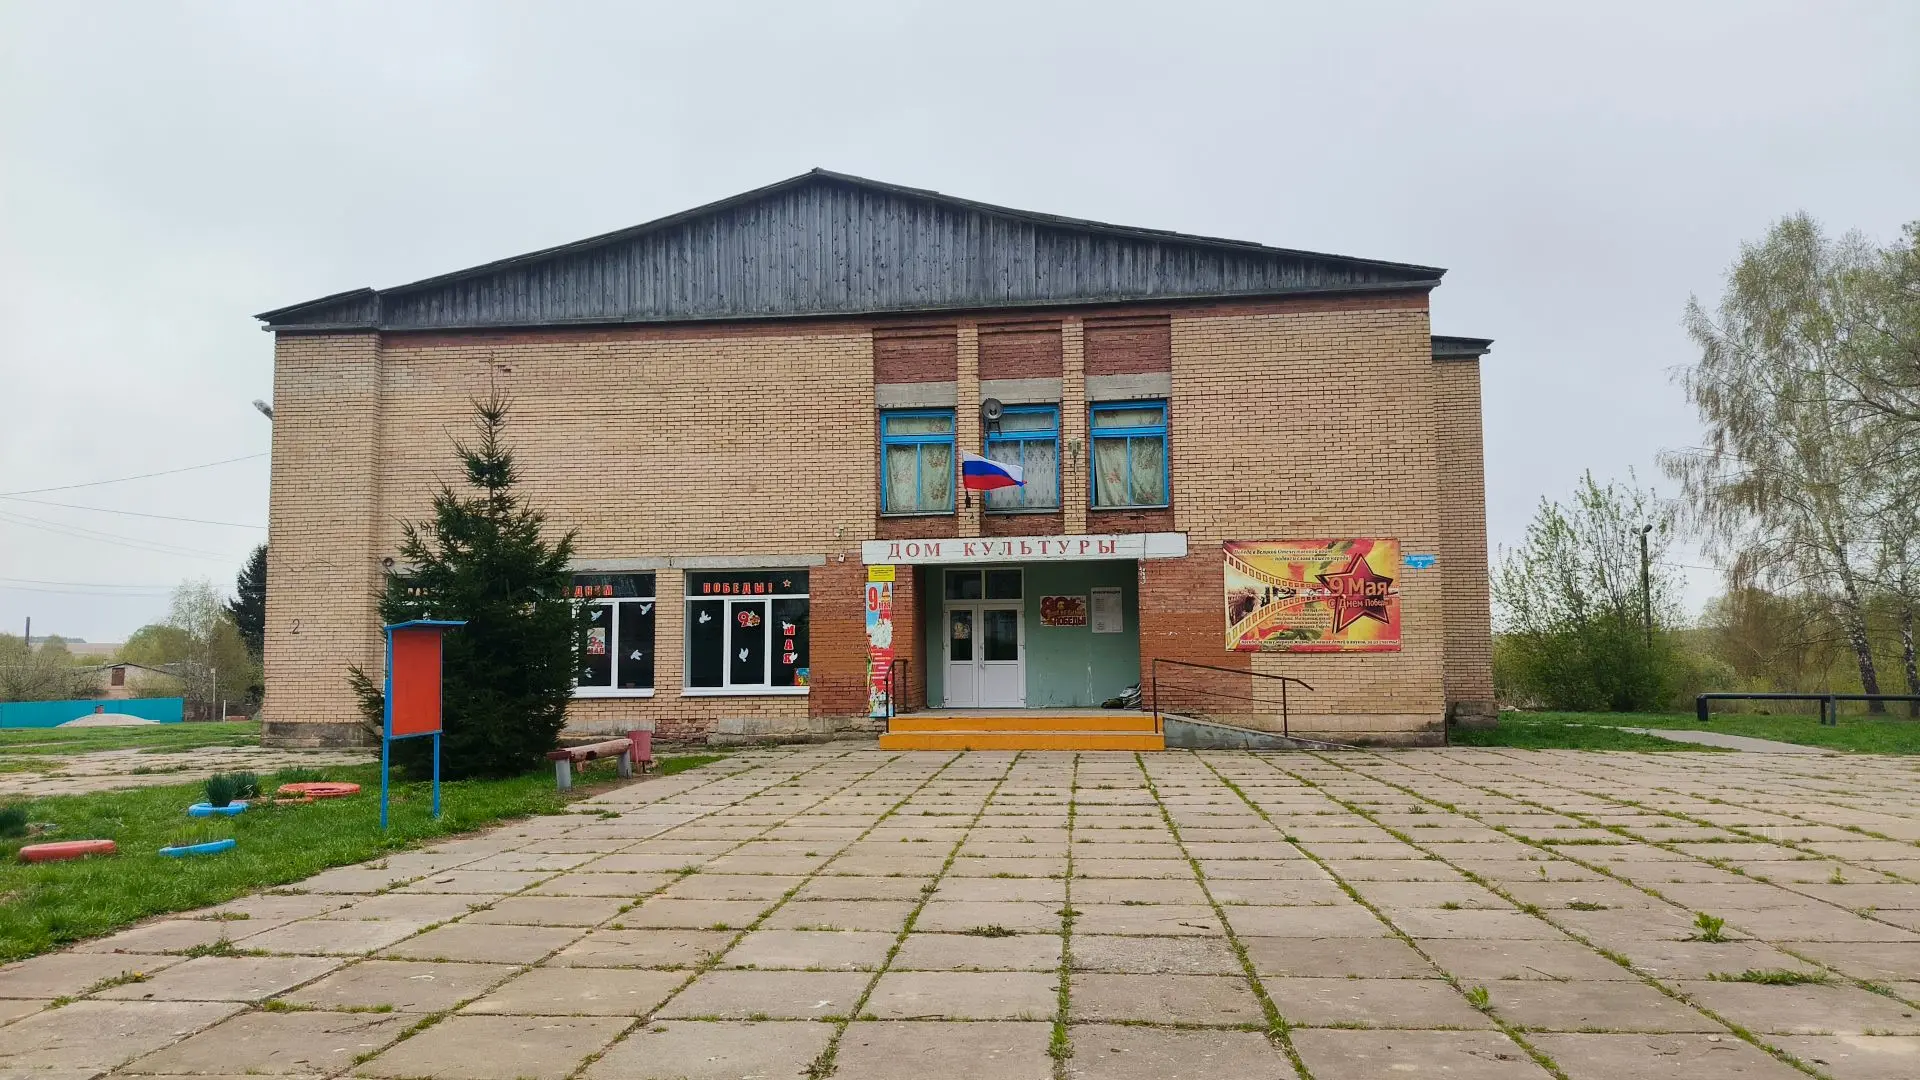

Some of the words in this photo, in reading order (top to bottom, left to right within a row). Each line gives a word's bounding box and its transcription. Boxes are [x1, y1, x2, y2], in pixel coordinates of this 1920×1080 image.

[887, 541, 941, 560] ДОМ
[963, 539, 1117, 557] КУЛЬТУРЫ
[1329, 577, 1344, 596] 9
[1348, 577, 1387, 596] Мая
[868, 586, 878, 611] 9
[1339, 597, 1363, 610] Днем
[291, 619, 300, 634] 2
[738, 611, 750, 627] 9
[1054, 616, 1087, 626] ПОБЕДЫ
